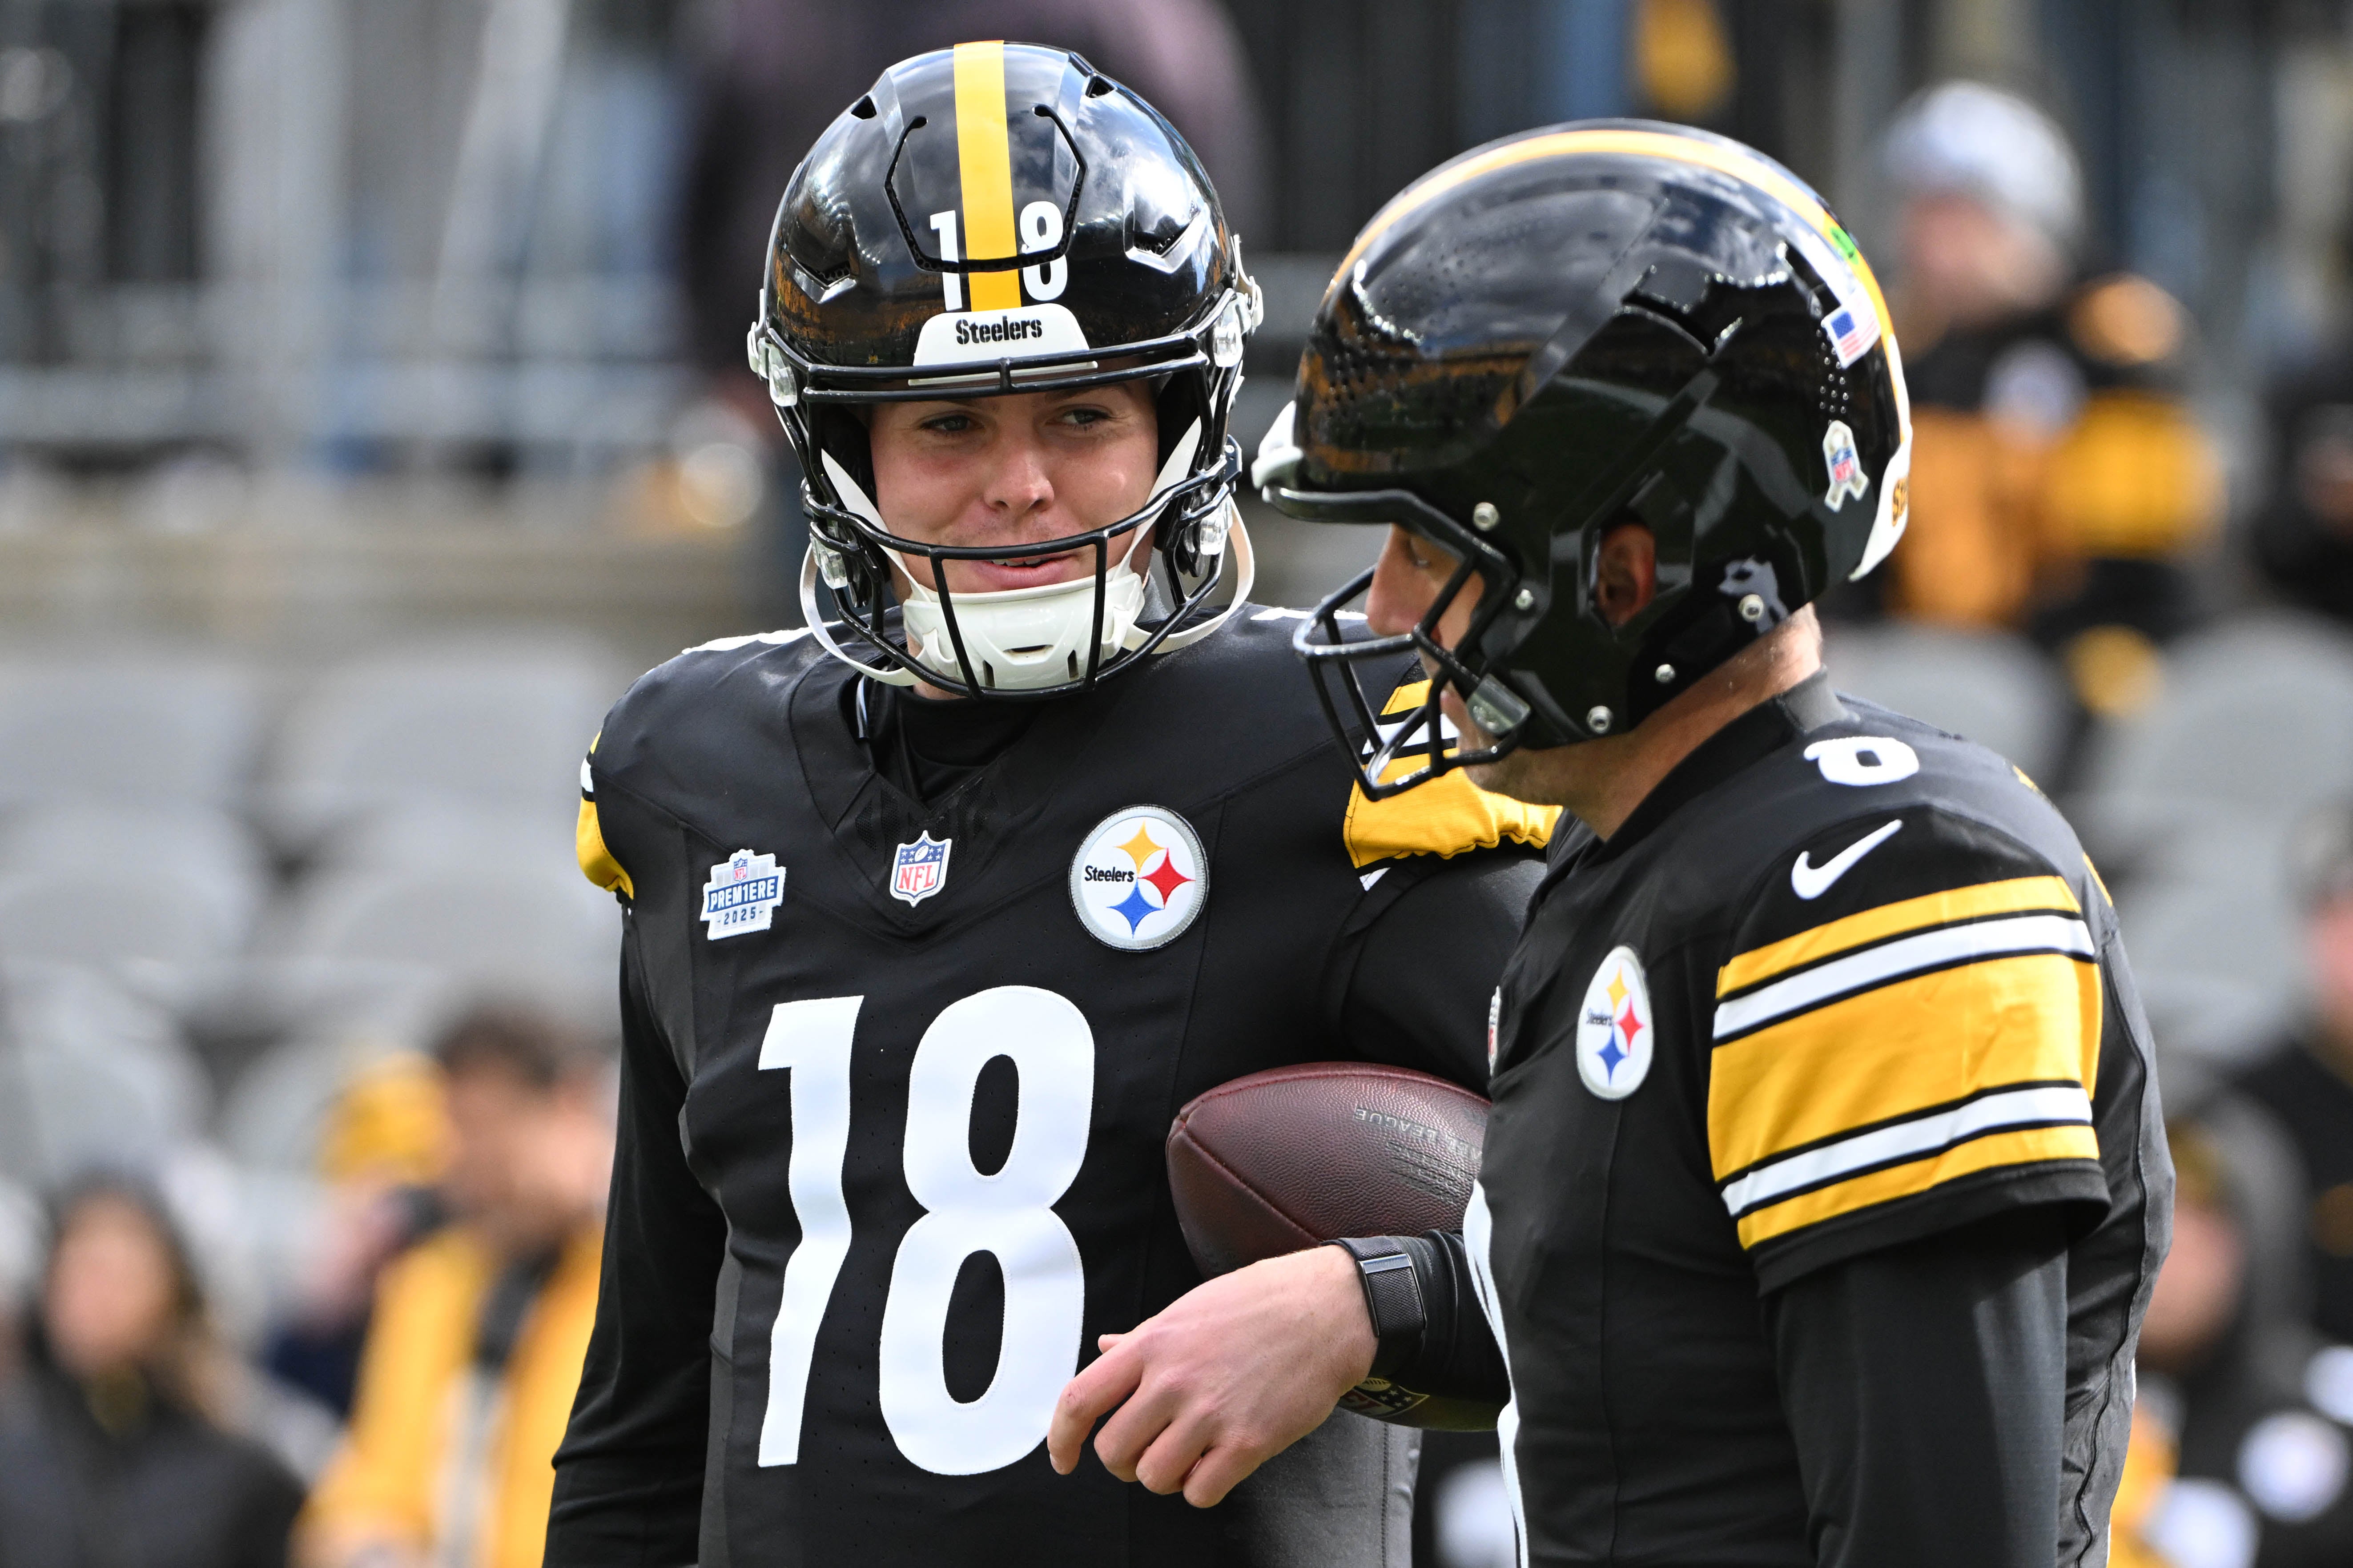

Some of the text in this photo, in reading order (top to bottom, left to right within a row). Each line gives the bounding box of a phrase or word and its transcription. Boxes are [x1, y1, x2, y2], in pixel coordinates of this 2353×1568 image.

[956, 315, 1042, 345] Steelers
[734, 868, 747, 880] NFL
[898, 865, 934, 892] NFL
[1084, 865, 1134, 883] Steelers
[724, 906, 756, 925] 2025
[1586, 1008, 1613, 1027] Steelers
[1355, 1108, 1438, 1142] LEAGUE
[758, 985, 1095, 1475] 18
